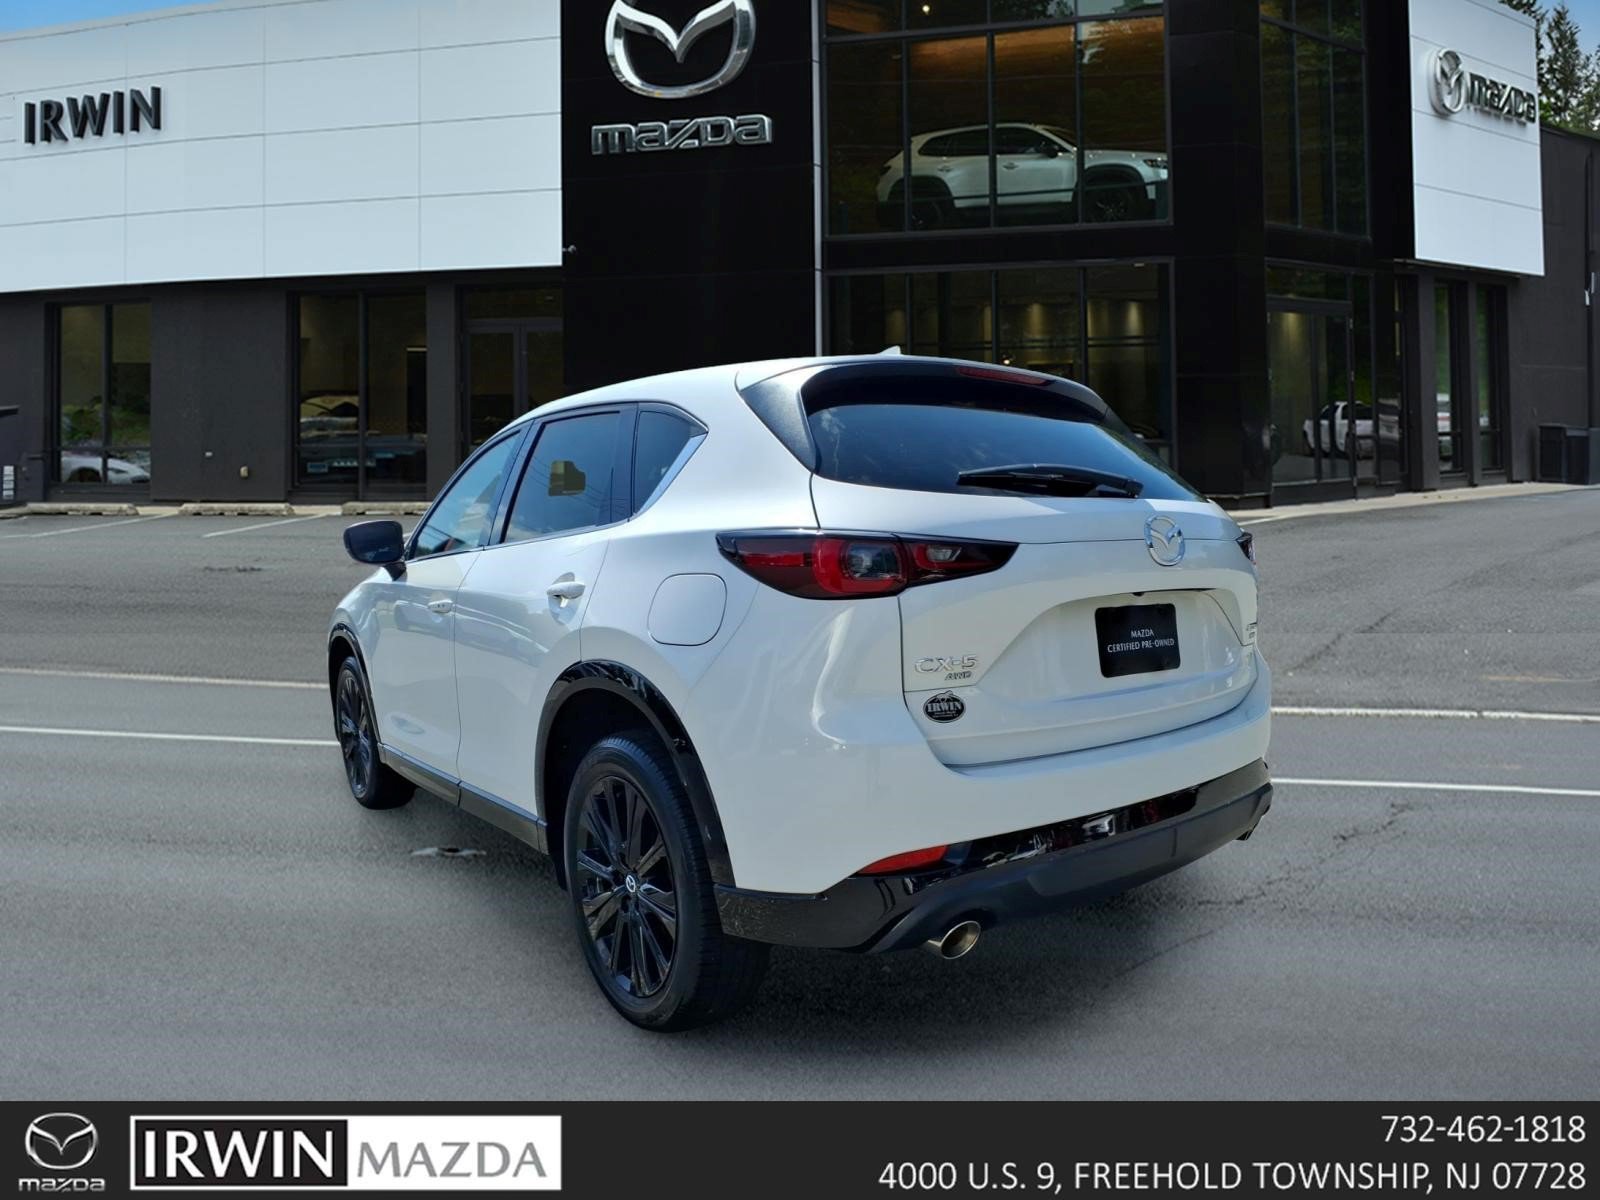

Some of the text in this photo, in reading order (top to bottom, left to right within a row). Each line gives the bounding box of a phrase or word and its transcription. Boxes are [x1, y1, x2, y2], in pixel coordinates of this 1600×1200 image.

[24, 85, 162, 145] IRWIN
[1130, 628, 1154, 638] MAZDA
[1107, 638, 1175, 653] CERTIFIED PRE-OWNED
[914, 655, 977, 673] CX-5
[944, 670, 972, 681] AWD
[927, 701, 962, 713] IRWIN
